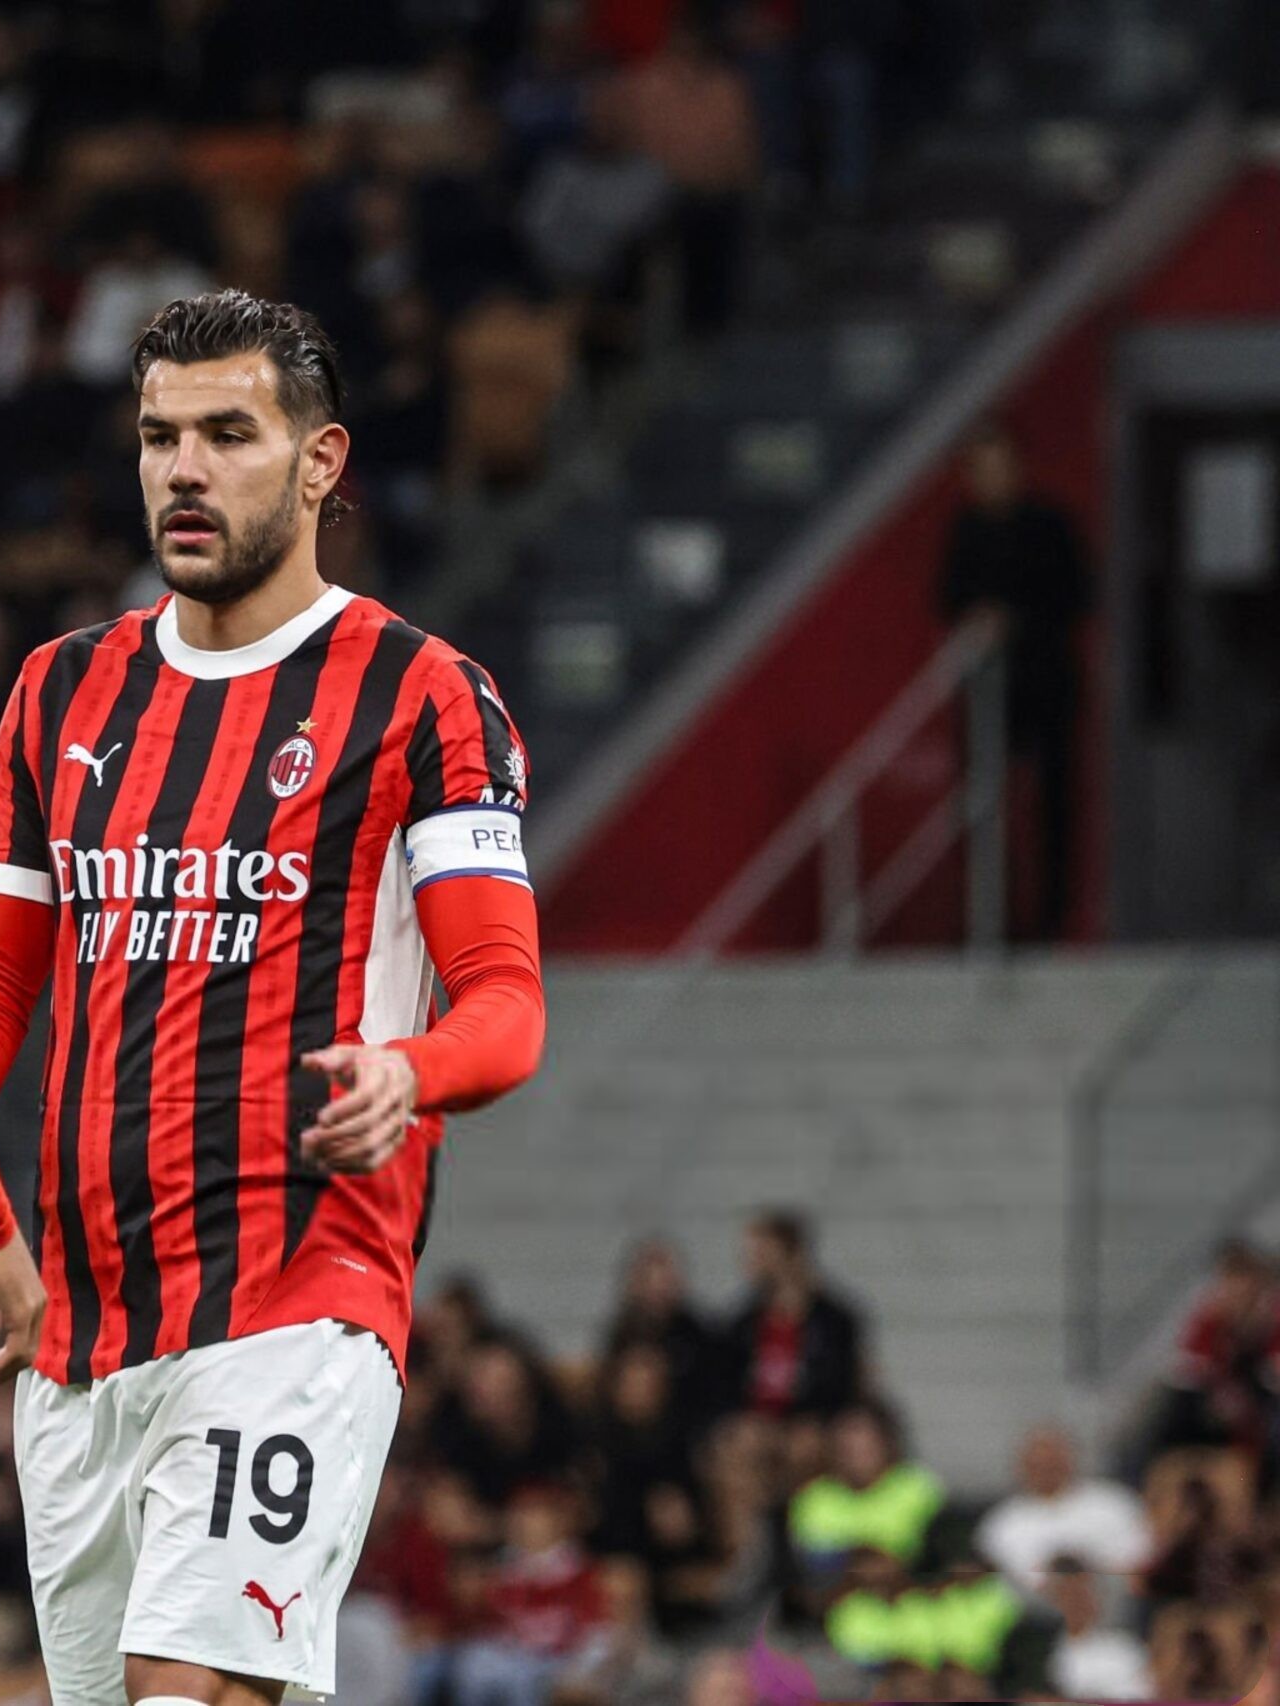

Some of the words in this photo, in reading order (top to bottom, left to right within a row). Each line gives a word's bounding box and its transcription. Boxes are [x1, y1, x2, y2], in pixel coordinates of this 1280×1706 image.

[49, 833, 310, 901] Emirates
[77, 911, 121, 964] FLY
[124, 910, 258, 963] BETTER
[205, 1428, 314, 1544] 19
